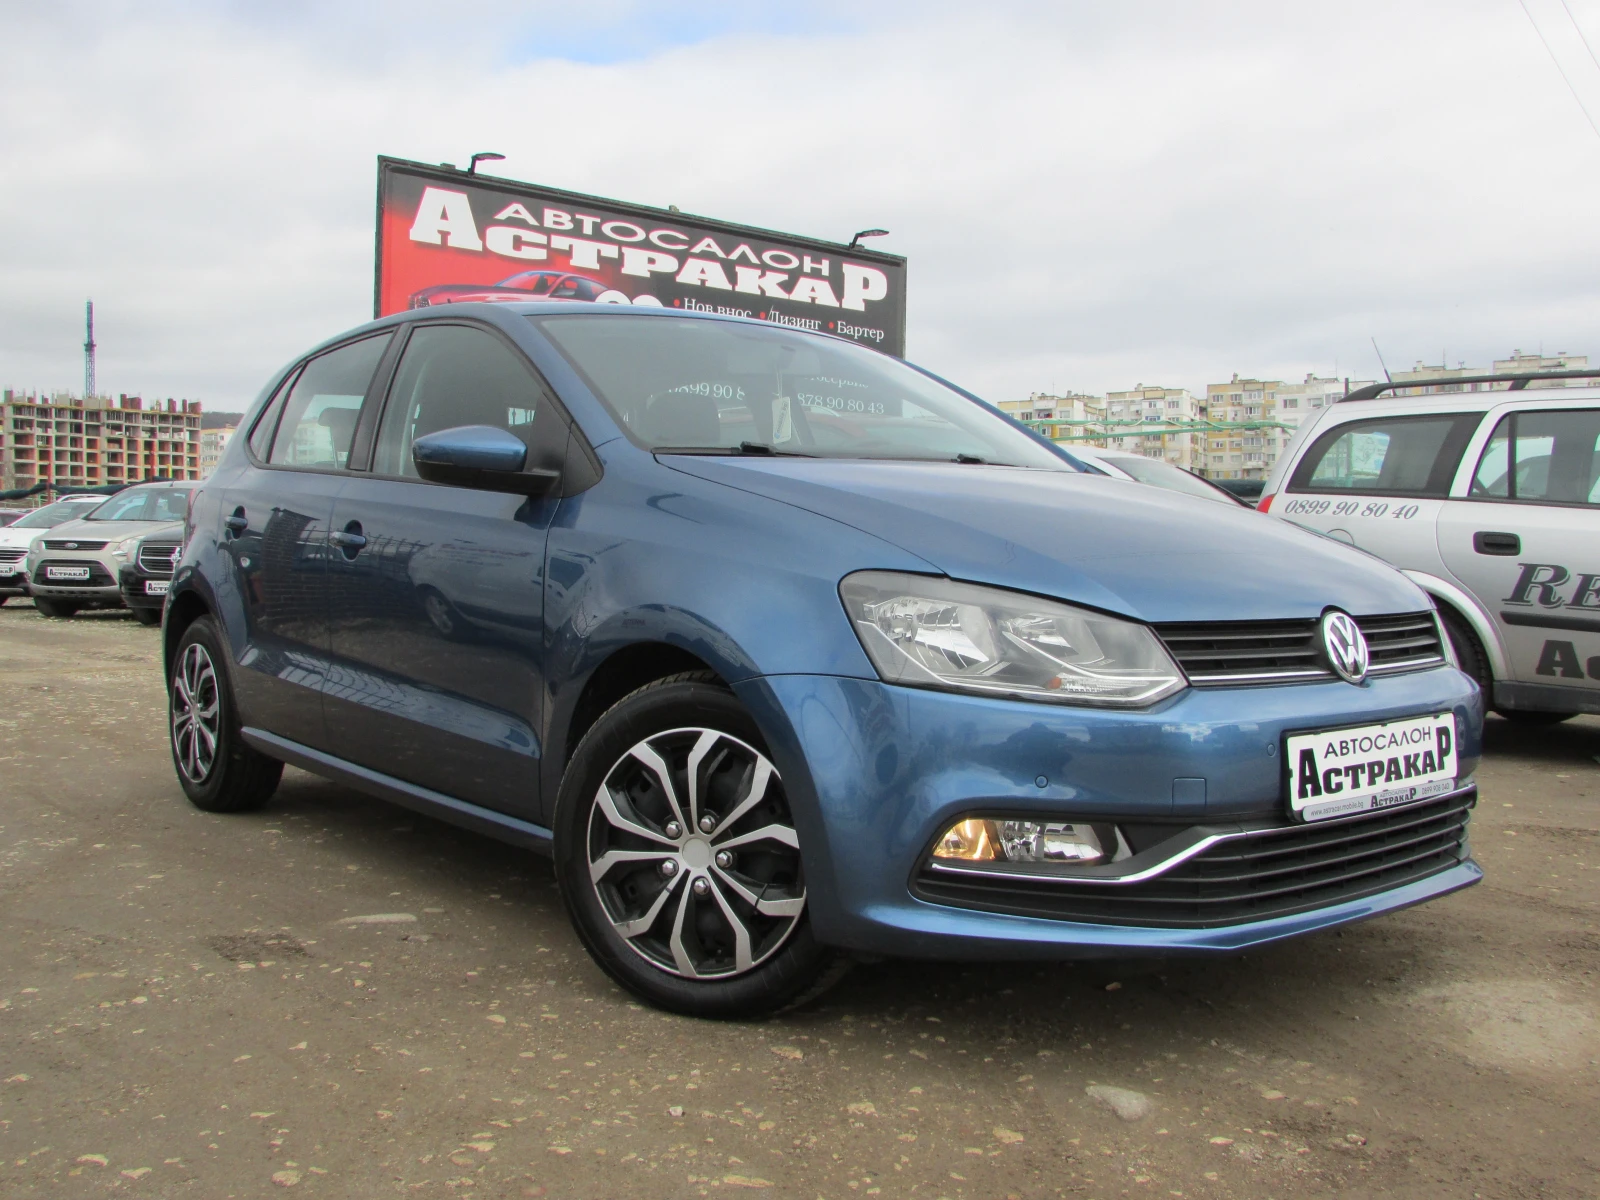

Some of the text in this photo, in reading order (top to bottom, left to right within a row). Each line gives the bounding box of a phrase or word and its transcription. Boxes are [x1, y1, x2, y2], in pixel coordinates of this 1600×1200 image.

[409, 185, 888, 311] АСТРАКАР
[493, 202, 831, 277] АВТОСАЛОН
[770, 309, 822, 331] Лизинг
[836, 320, 885, 340] Бартер
[668, 382, 710, 396] 99
[713, 383, 733, 399] 90
[826, 396, 844, 410] 90
[847, 399, 864, 412] 80
[867, 402, 884, 415] 43
[1284, 499, 1419, 520] 0899 90 80 40
[1323, 725, 1432, 759] АВТОСАЛОН
[1297, 725, 1452, 800] АСТРАКАР
